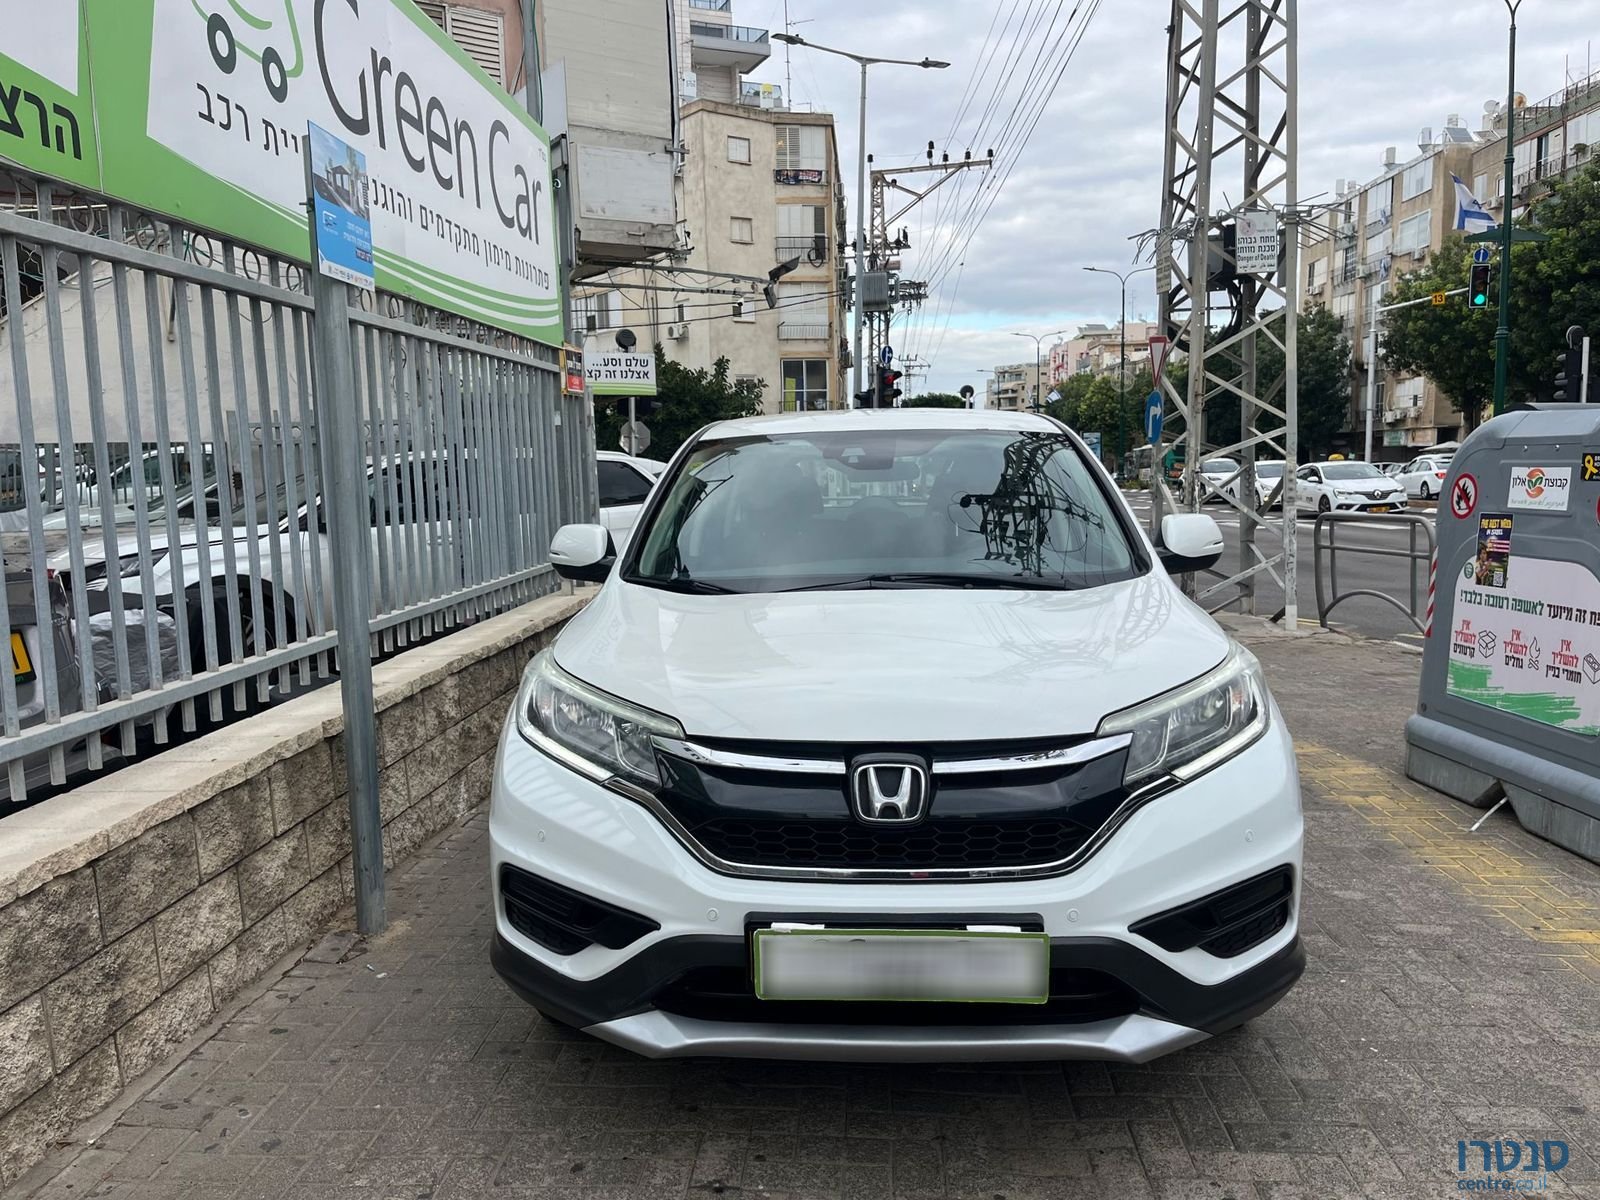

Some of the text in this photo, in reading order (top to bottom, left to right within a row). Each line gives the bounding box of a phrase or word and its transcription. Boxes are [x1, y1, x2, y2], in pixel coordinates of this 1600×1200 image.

[196, 82, 251, 142] רכב
[313, 0, 542, 245] Green Car
[419, 204, 480, 256] מתקדמים
[483, 239, 511, 271] מימון
[1237, 254, 1254, 263] Danger
[515, 255, 549, 290] פתרונות
[1433, 294, 1444, 303] 13
[592, 357, 649, 368] שלם וסע...
[605, 369, 617, 379] זה
[620, 368, 650, 379] אצלנו
[1511, 475, 1568, 490] קבוצת אלון
[1460, 589, 1482, 605] בלבד!
[1484, 593, 1509, 610] רטובה
[1511, 597, 1544, 616] לאשפה
[1546, 603, 1573, 621] מיועד
[1575, 608, 1587, 624] זה
[1461, 619, 1471, 630] אין
[1454, 629, 1476, 645] להשליך
[1511, 629, 1521, 641] אין
[1453, 643, 1475, 659] קרטונים
[1503, 640, 1528, 656] להשליך
[1560, 639, 1572, 652] אין
[1504, 655, 1523, 669] גחלים
[1552, 651, 1579, 668] להשליך
[1562, 668, 1582, 684] חומרי
